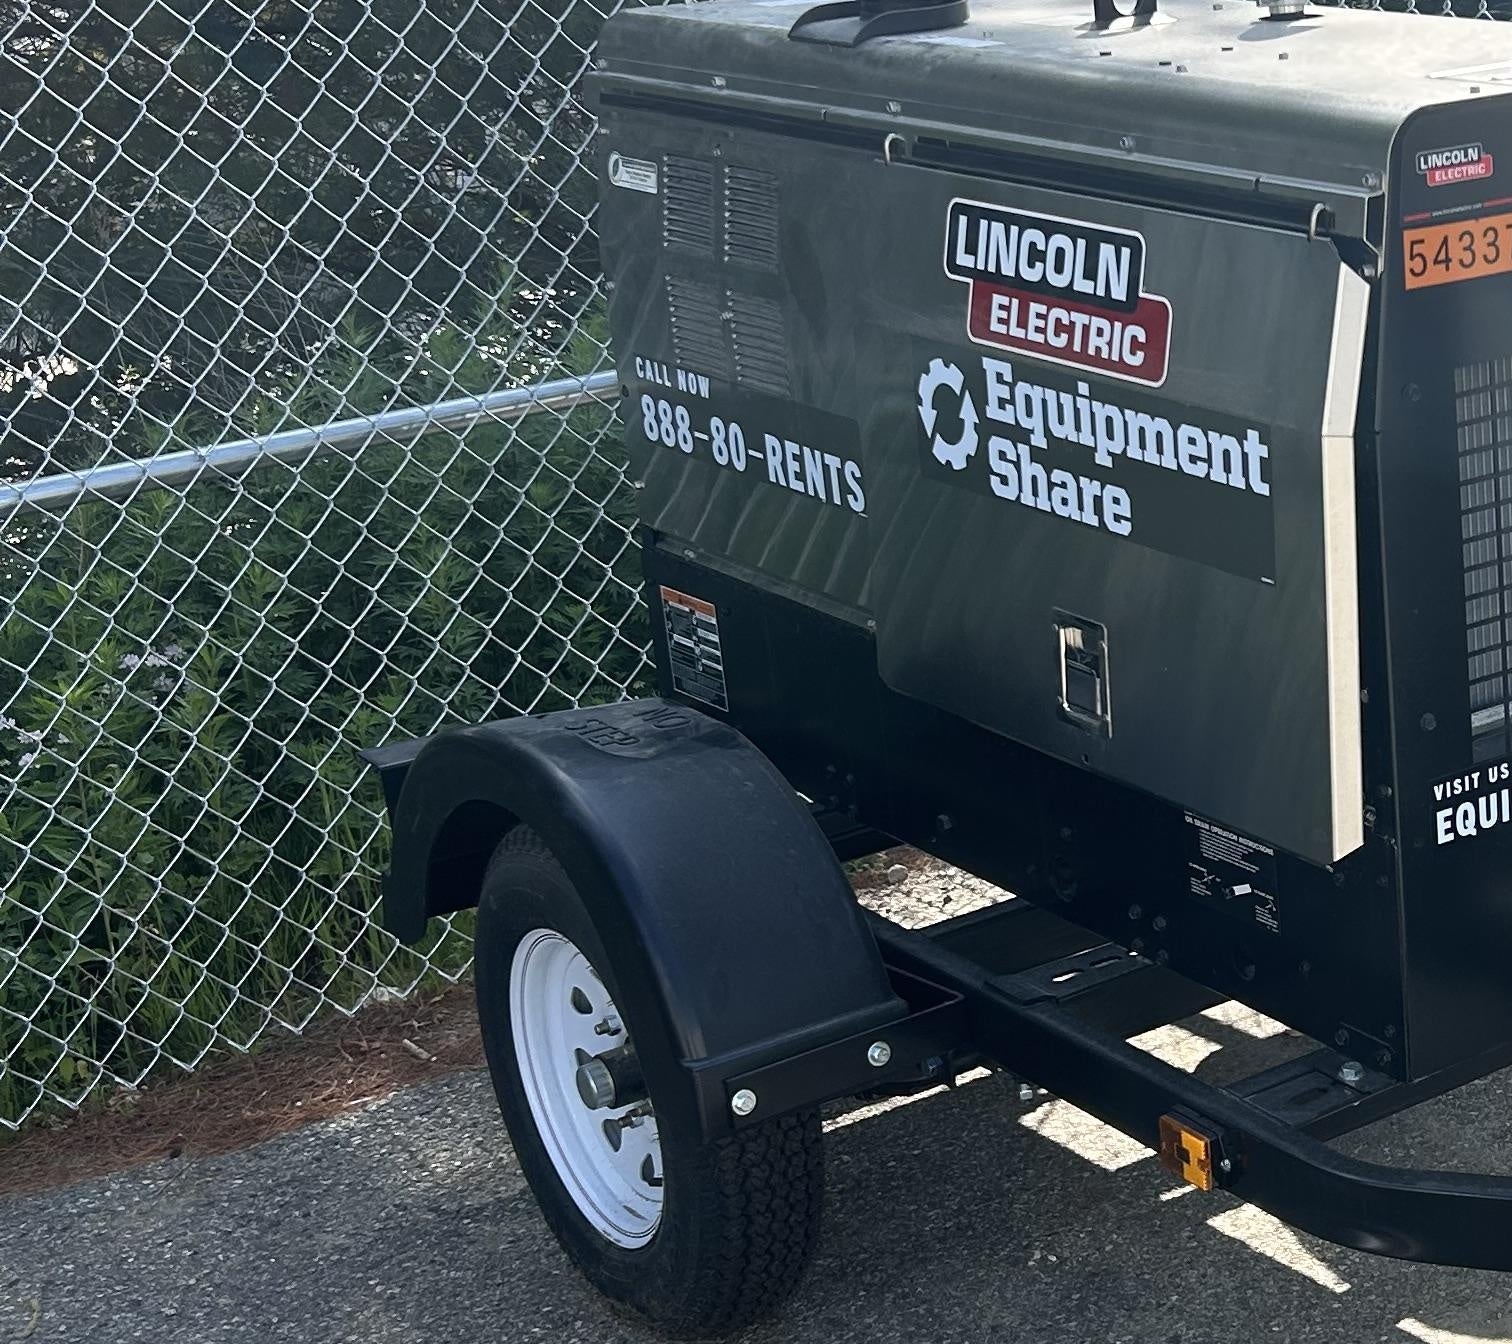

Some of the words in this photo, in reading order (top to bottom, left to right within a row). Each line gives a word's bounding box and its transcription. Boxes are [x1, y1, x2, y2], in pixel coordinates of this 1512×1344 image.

[1420, 147, 1479, 170] LINCOLN
[1435, 162, 1486, 182] ELECTRIC
[956, 215, 1132, 302] LINCOLN
[989, 293, 1147, 367] ELECTRIC
[635, 356, 672, 387] CALL
[676, 368, 710, 399] NOW
[982, 356, 1270, 497] Equipment
[641, 394, 865, 513] 888-80-RENTS
[987, 435, 1133, 537] Share
[564, 719, 641, 747] STEP
[632, 707, 692, 729] NO
[1433, 771, 1480, 801] VISIT
[1488, 761, 1510, 784] US
